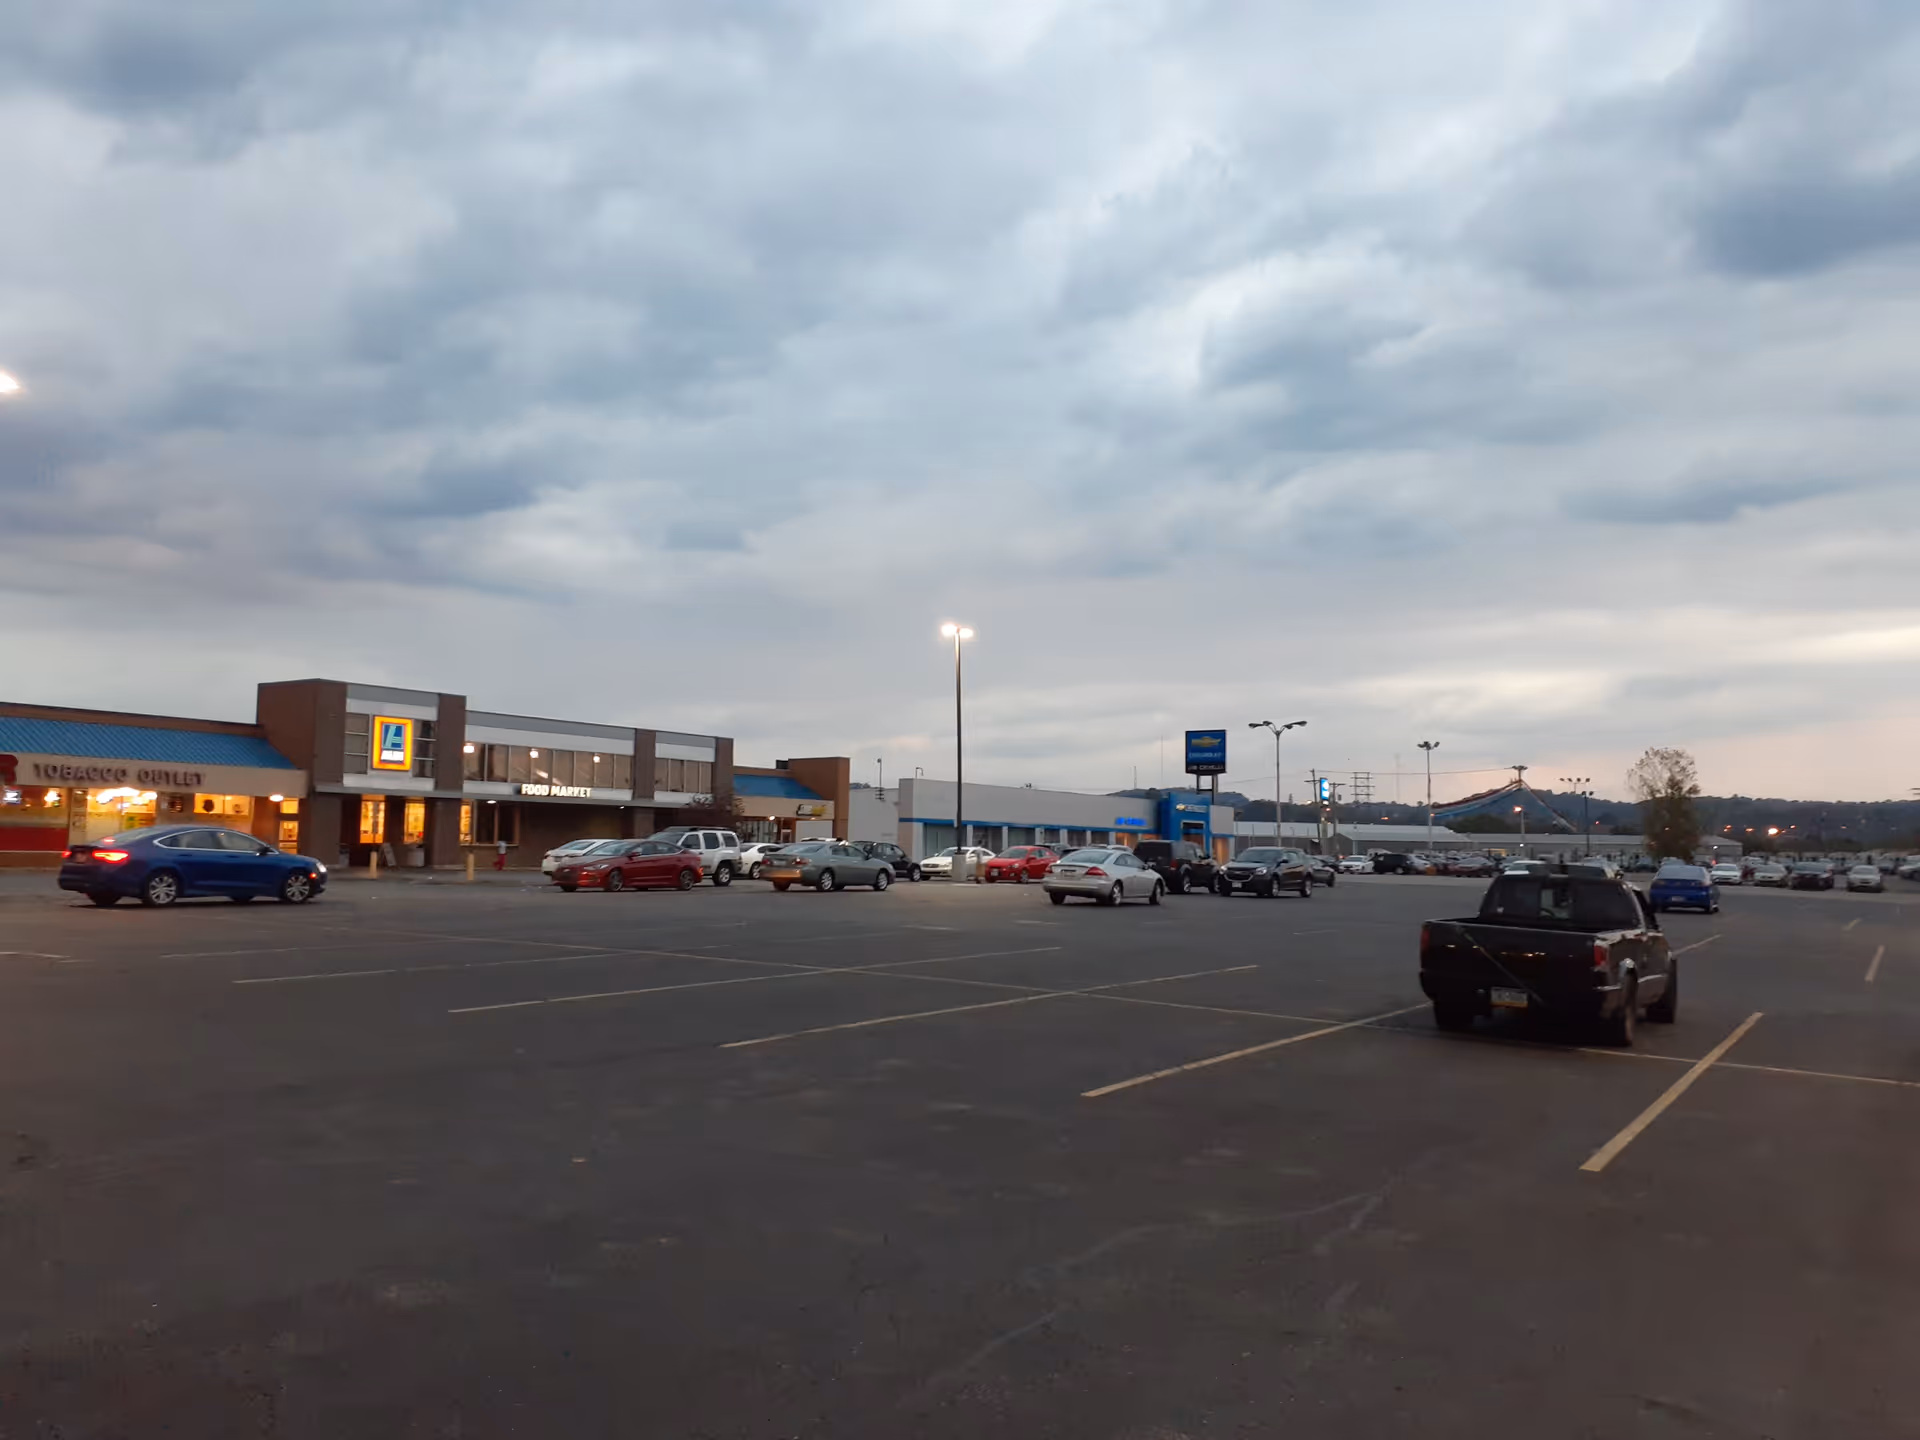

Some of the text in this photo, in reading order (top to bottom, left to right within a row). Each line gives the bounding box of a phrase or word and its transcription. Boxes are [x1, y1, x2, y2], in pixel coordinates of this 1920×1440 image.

[33, 763, 206, 787] TOBACCO OUTLET
[521, 783, 592, 798] FOOD MARKET
